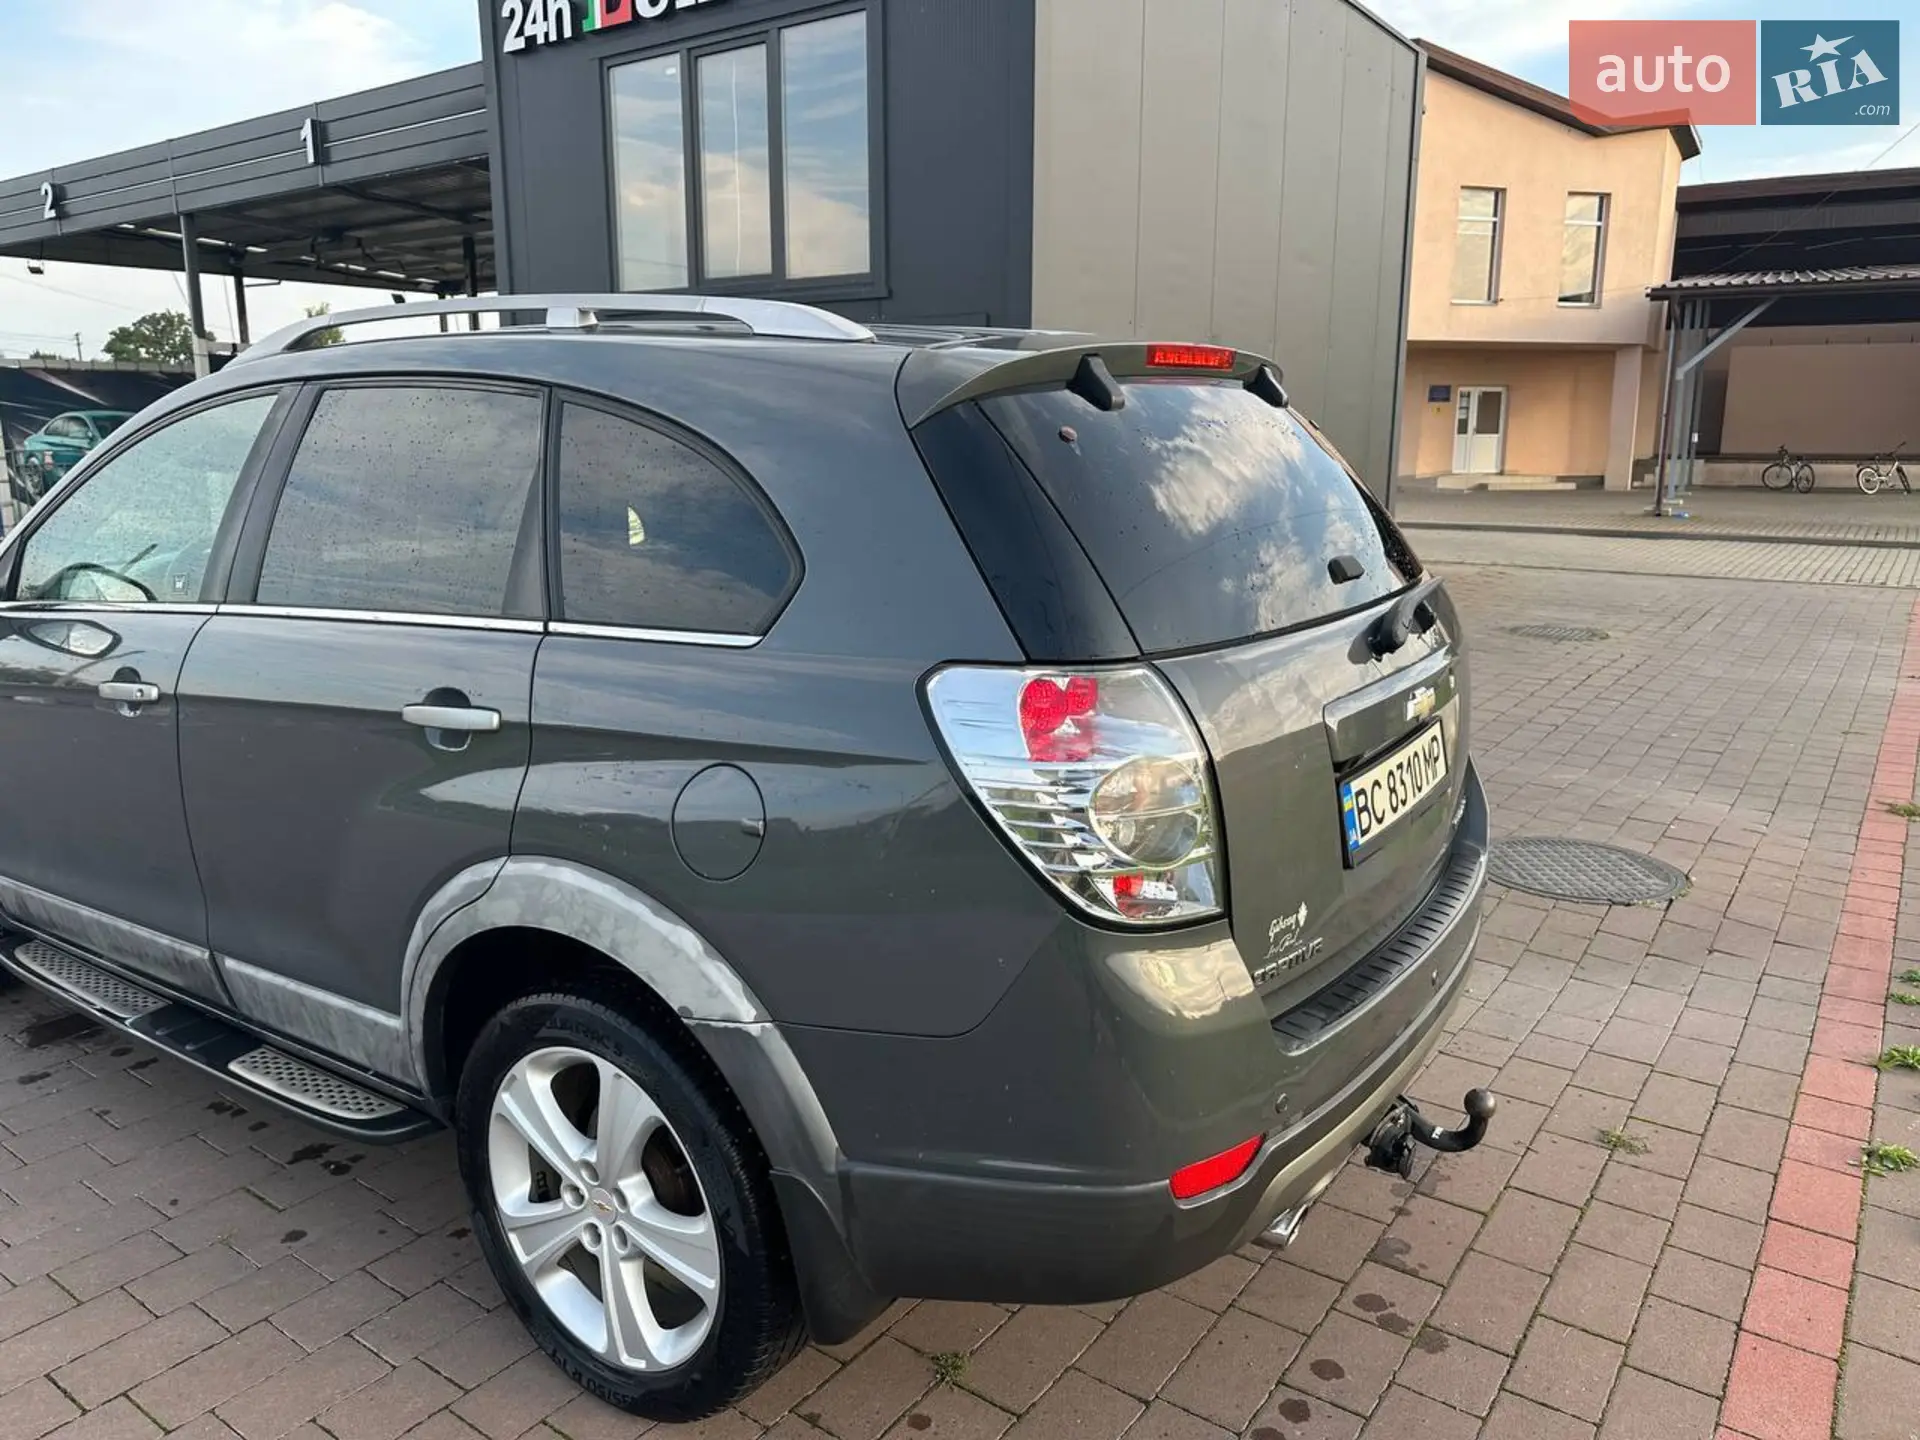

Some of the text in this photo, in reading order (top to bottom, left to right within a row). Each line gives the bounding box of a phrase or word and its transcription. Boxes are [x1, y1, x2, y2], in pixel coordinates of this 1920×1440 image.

[501, 0, 572, 53] 24h
[300, 117, 318, 164] 1
[40, 181, 57, 220] 2
[1354, 735, 1440, 837] BC 8310 MP
